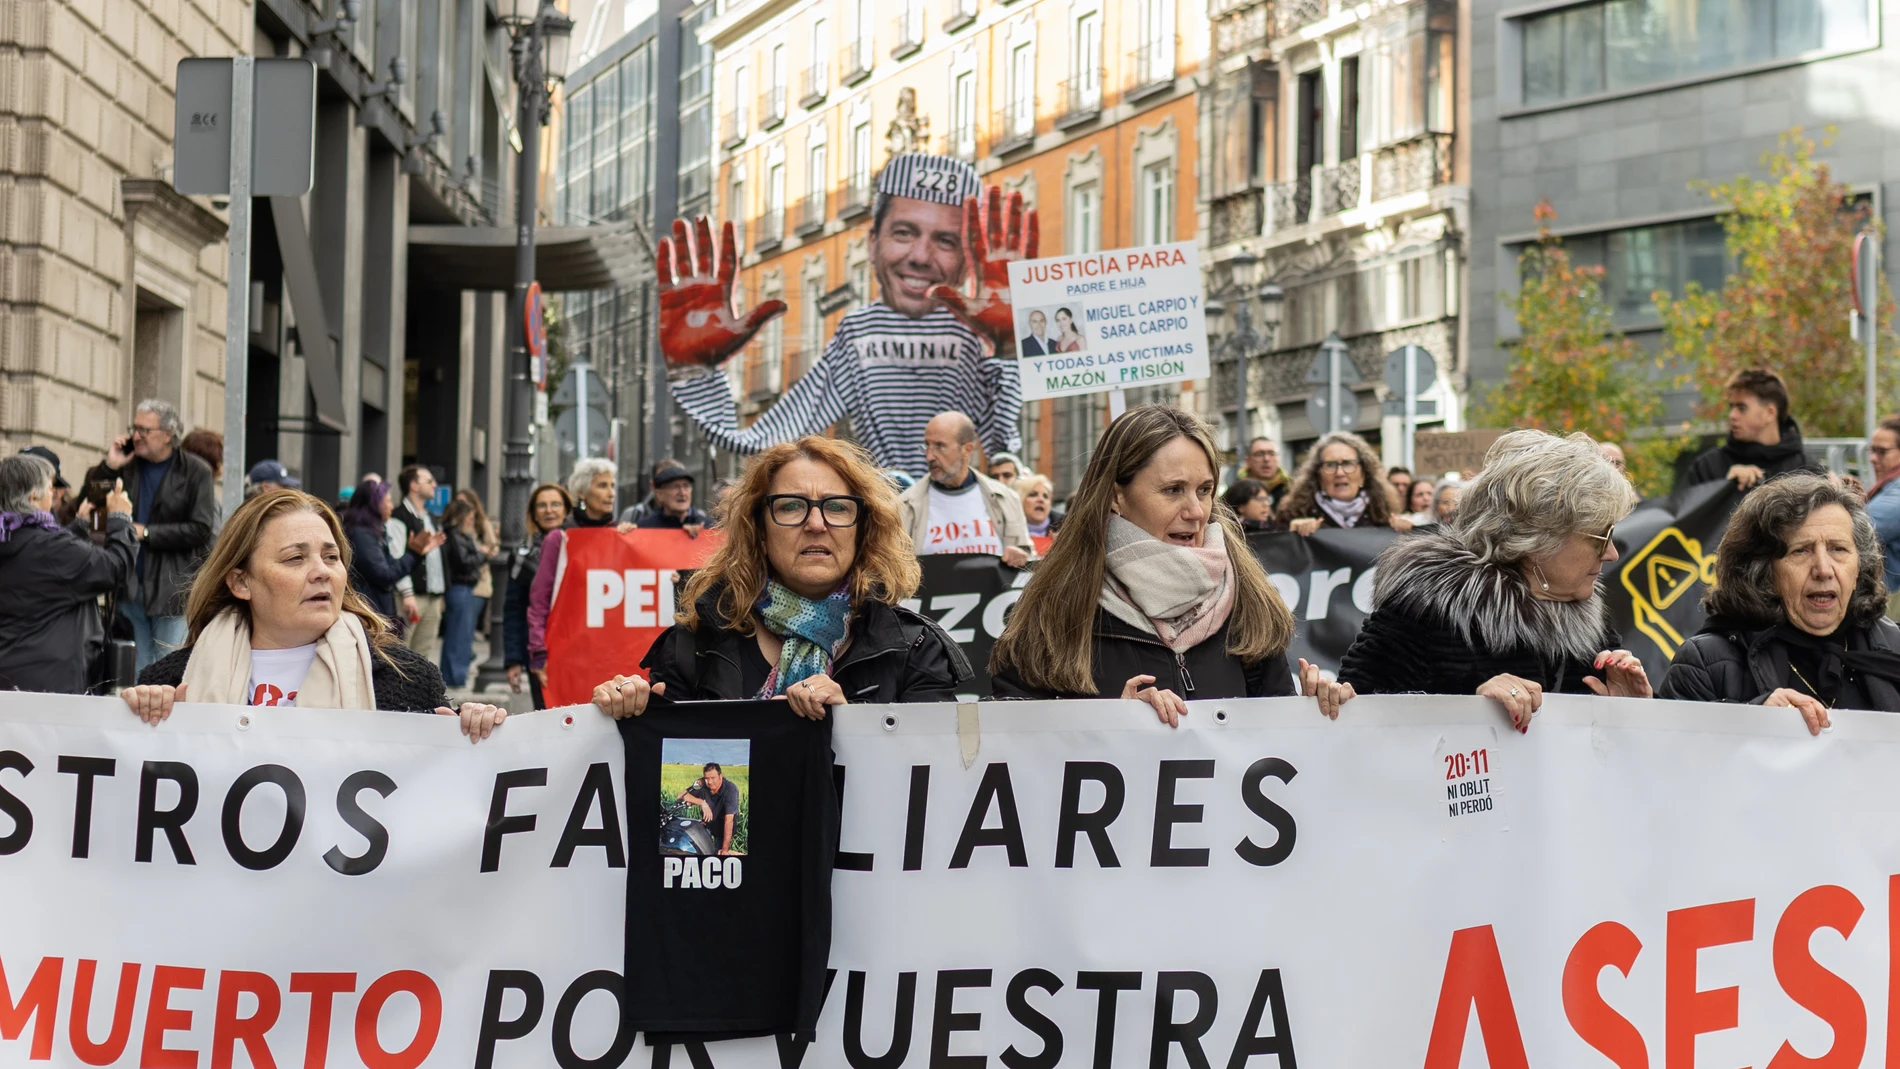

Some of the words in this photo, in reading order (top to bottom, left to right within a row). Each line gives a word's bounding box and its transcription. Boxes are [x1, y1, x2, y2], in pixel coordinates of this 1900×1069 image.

[916, 170, 958, 192] 228
[1127, 249, 1186, 271] PARA
[1067, 282, 1105, 295] PADRE
[1110, 280, 1116, 289] E
[1120, 277, 1146, 289] HIJA
[1086, 305, 1135, 322] MIGUEL
[1139, 298, 1187, 315] CARPIO
[1190, 296, 1199, 309] Y
[1101, 322, 1136, 339] SARA
[1139, 317, 1188, 334] CARPIO
[1034, 362, 1043, 373] Y
[1047, 356, 1094, 371] TODAS
[1098, 352, 1125, 365] LAS
[1129, 343, 1193, 361] VICTIMAS
[1046, 370, 1106, 390] MAZÓN
[1120, 360, 1185, 381] PRISIÓN
[930, 519, 996, 544] 20:11
[1445, 749, 1489, 780] 20:11
[1447, 784, 1458, 800] NI
[1460, 779, 1490, 797] OBLIT
[1449, 803, 1458, 817] NI
[1460, 795, 1493, 815] PERDÓ
[663, 856, 742, 889] PACO
[0, 956, 443, 1069] MUERTO
